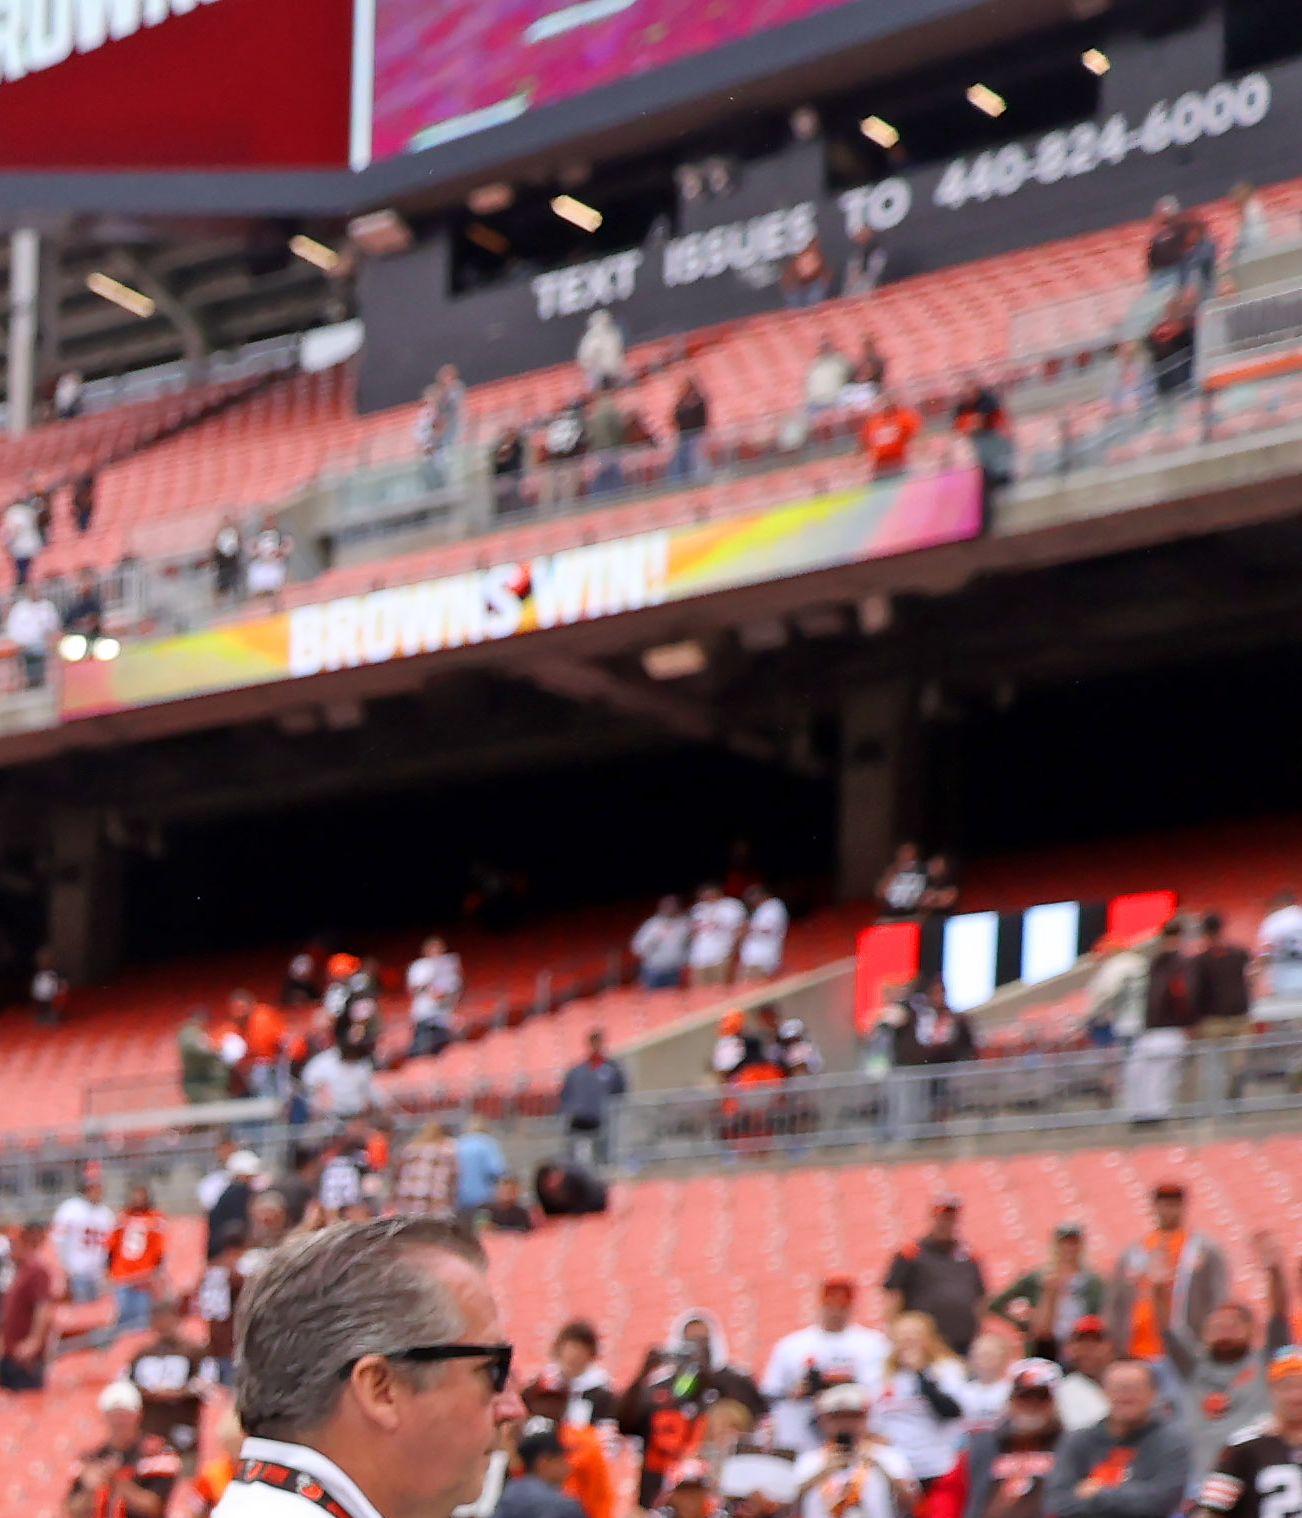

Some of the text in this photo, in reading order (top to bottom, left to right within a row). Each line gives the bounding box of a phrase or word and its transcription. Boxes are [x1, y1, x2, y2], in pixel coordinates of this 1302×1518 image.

[530, 71, 1272, 321] TEXT ISSUES TO 440-824-6000
[289, 528, 669, 679] BROWNS WIN!
